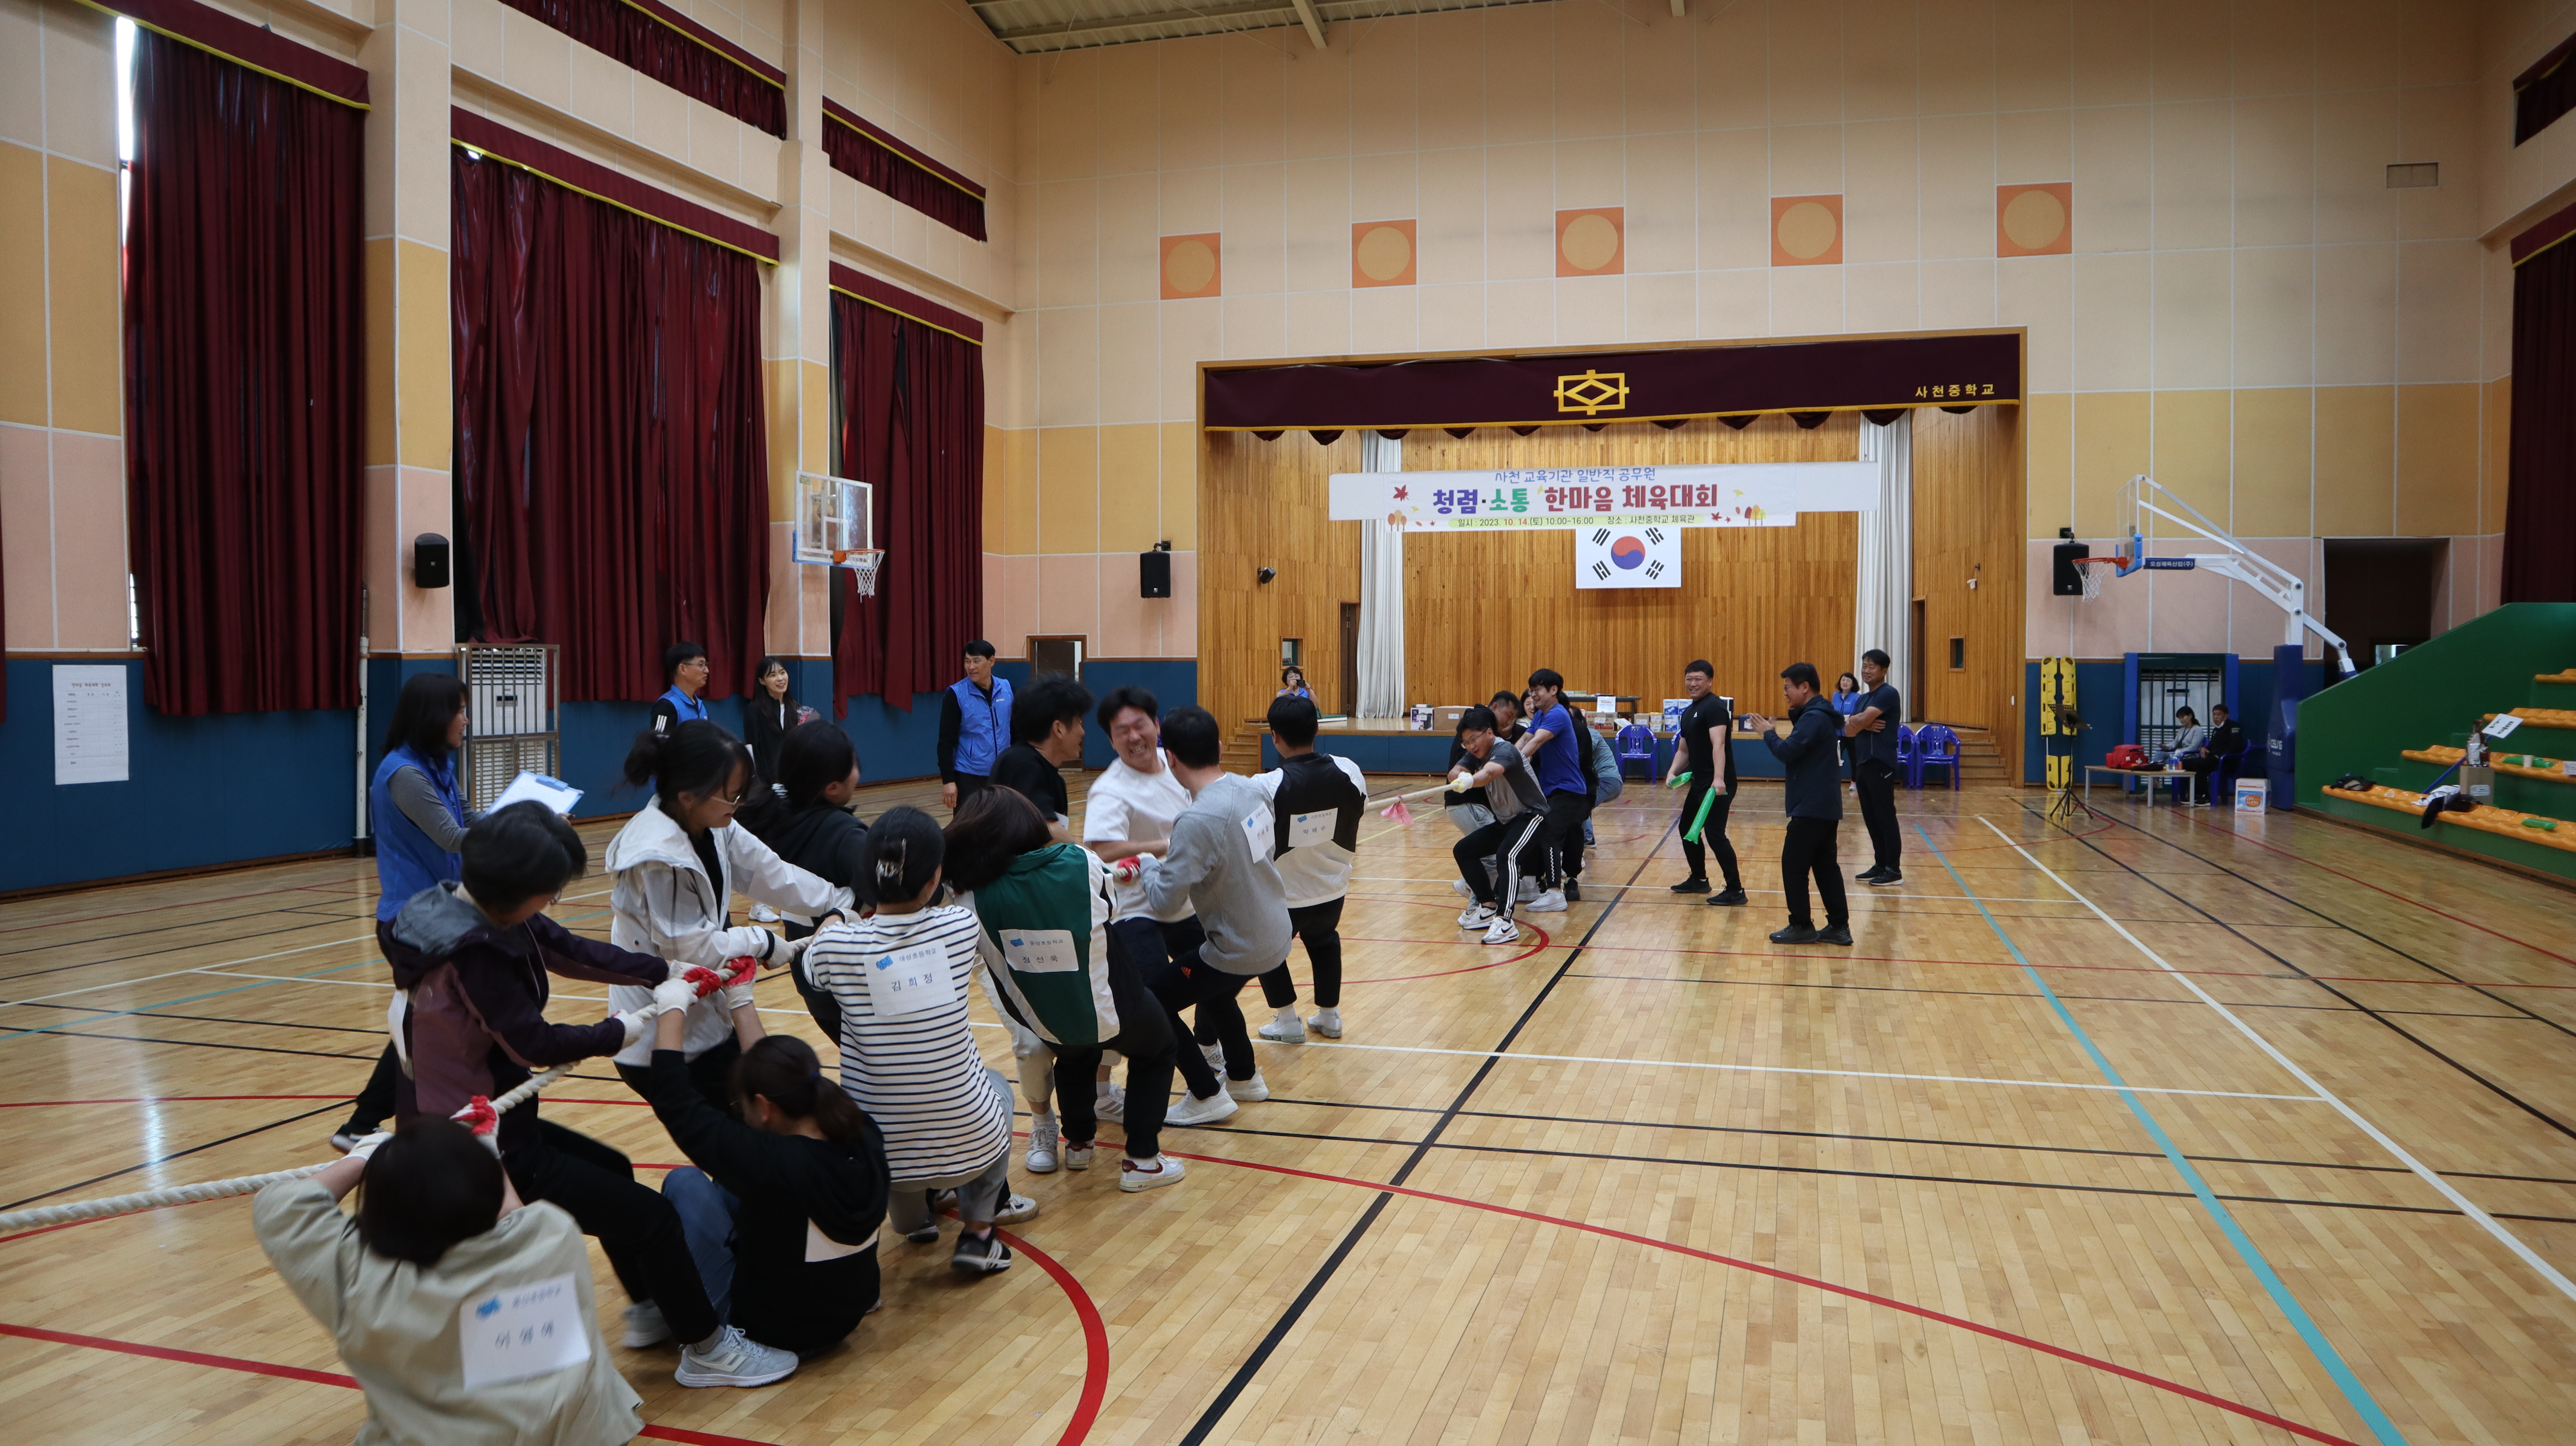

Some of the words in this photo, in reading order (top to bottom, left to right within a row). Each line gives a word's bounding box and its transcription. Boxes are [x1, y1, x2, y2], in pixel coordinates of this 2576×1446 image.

[1915, 384, 1994, 398] 사천중학교
[1495, 471, 1520, 484] 사천
[1524, 470, 1573, 483] 교육기관
[1577, 468, 1614, 482] 일반직
[1619, 467, 1656, 481] 공무원
[1544, 486, 1613, 512] 한마음
[1622, 484, 1717, 510] 체육대회
[1546, 516, 1594, 525] 10:00~16:00
[1607, 516, 1622, 524] 장소
[1629, 515, 1669, 524] 사천중학교
[1671, 515, 1695, 523] 체육관
[899, 947, 936, 962] 대성초등학교
